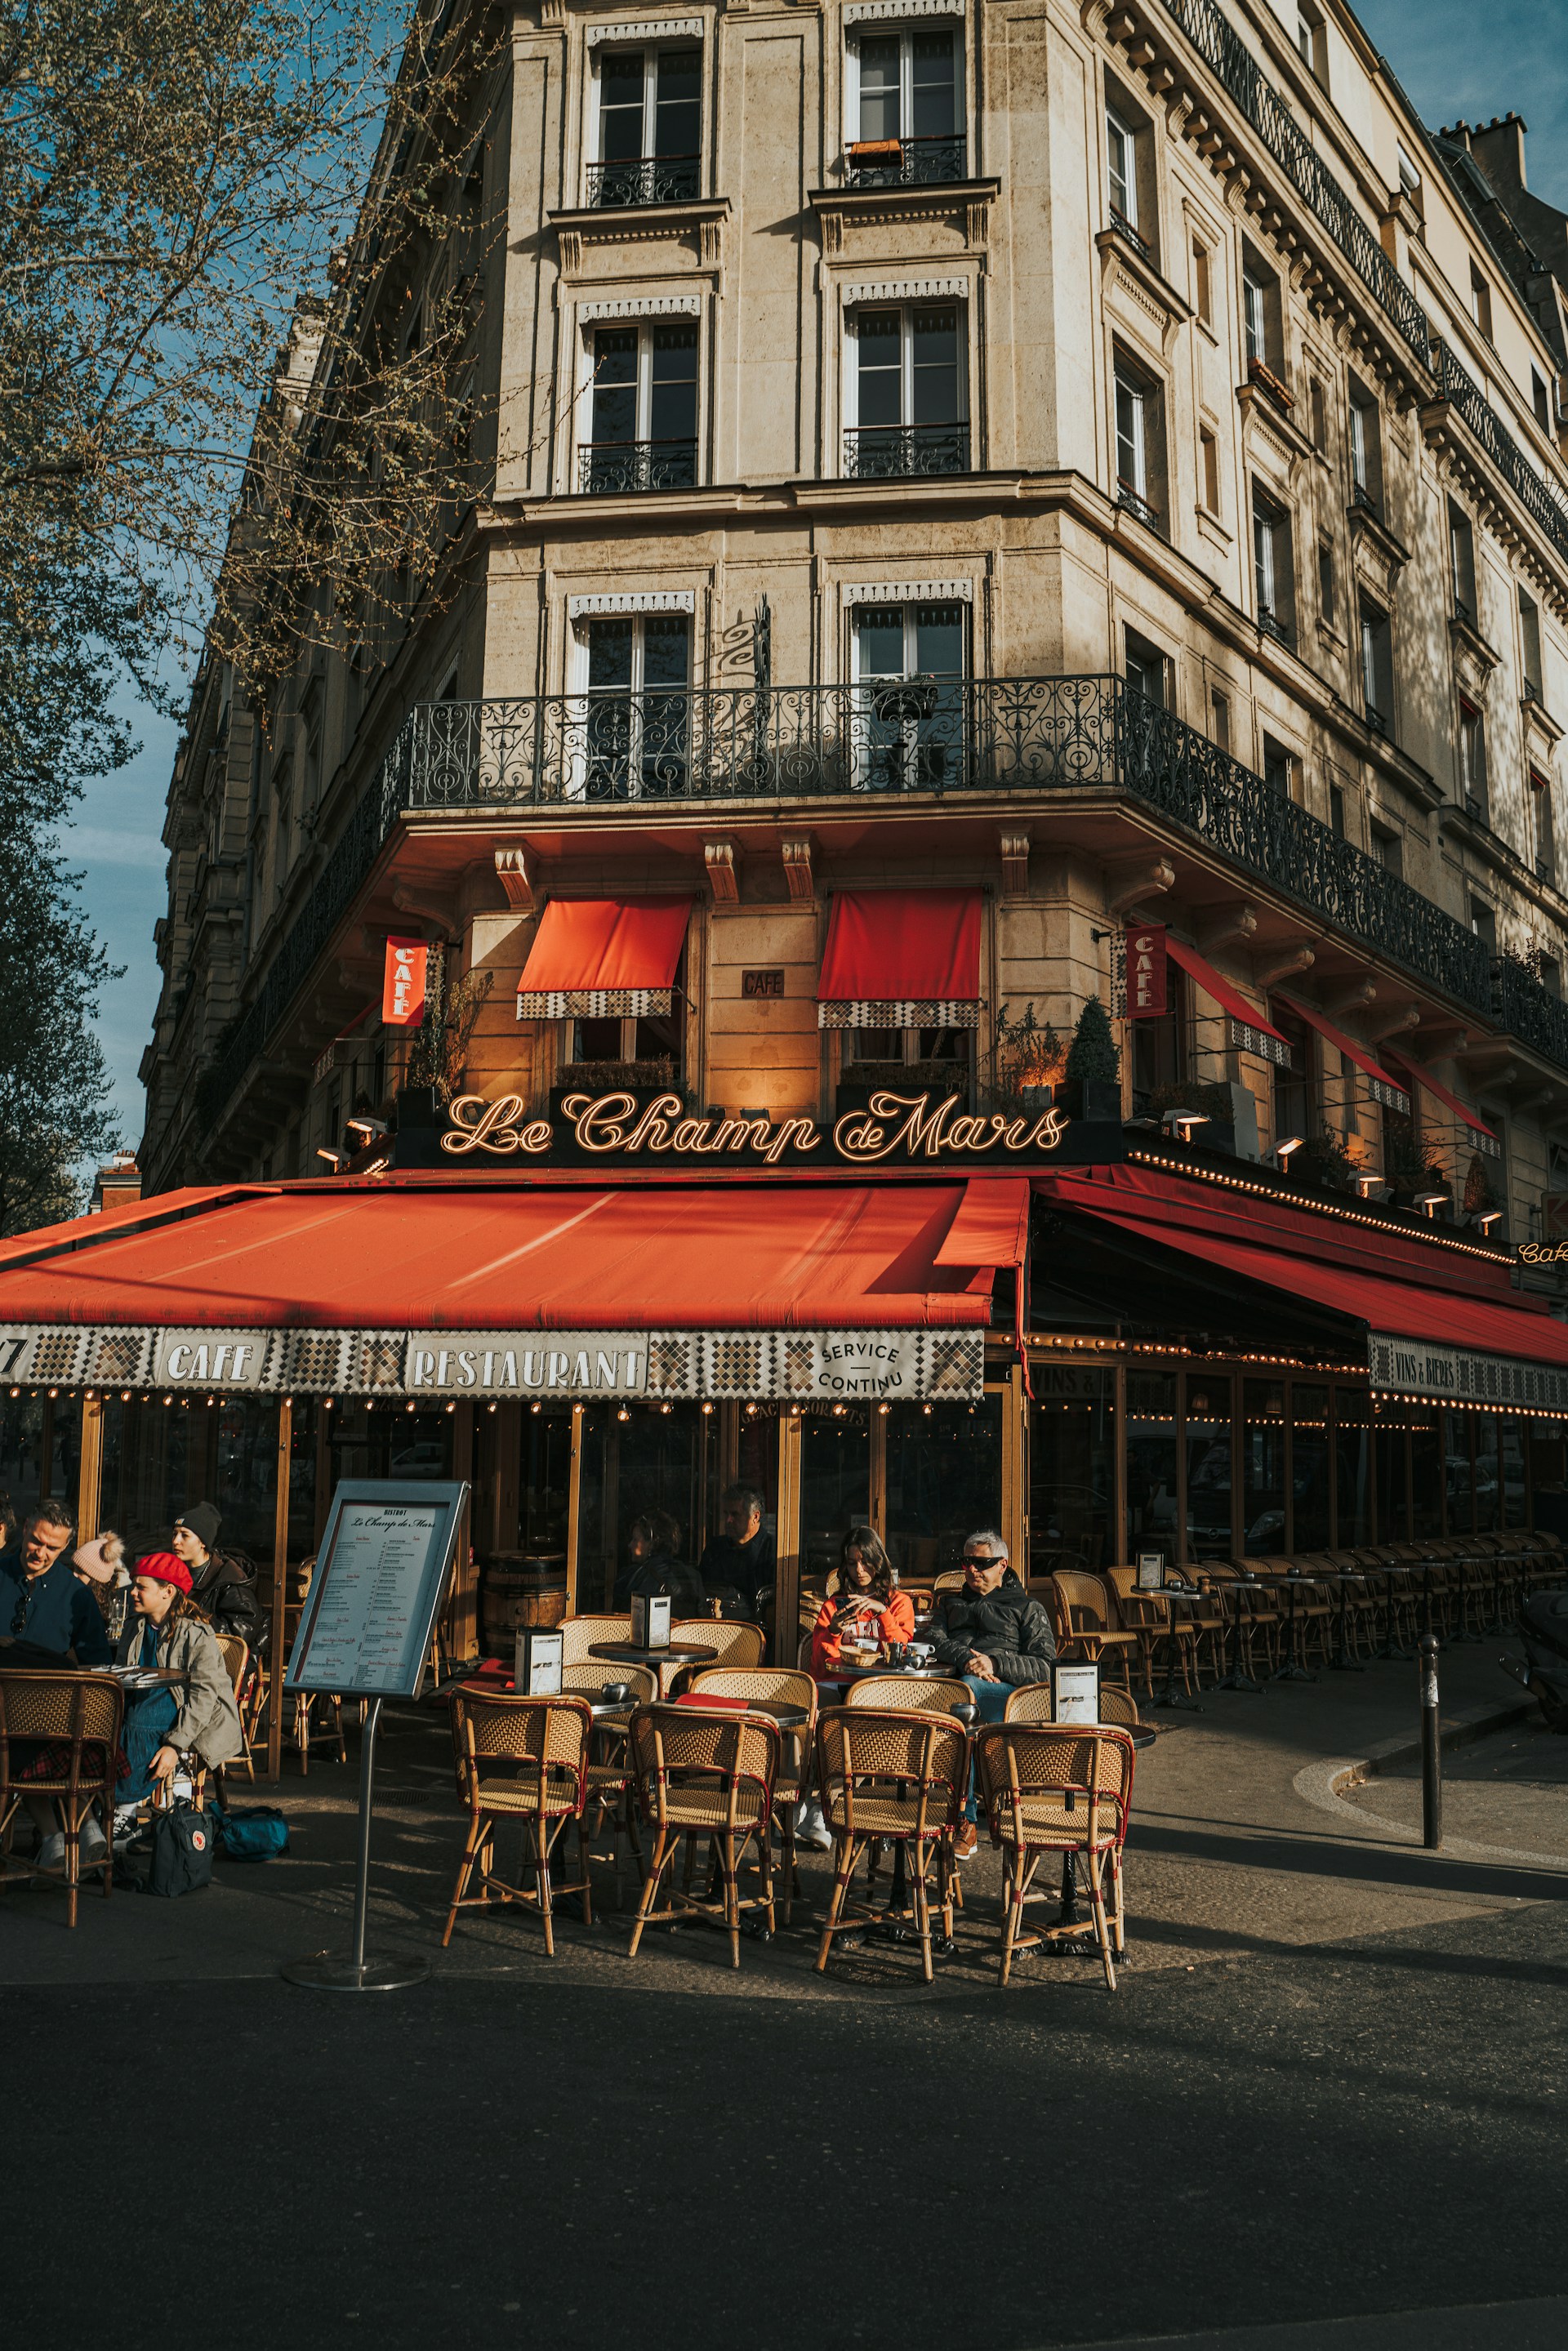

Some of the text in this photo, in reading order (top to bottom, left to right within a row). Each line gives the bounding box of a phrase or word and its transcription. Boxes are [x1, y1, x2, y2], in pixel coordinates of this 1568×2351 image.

[392, 947, 415, 1017] CAFÉ
[744, 972, 782, 995] CAFE
[439, 1090, 1071, 1164] Le Champ de Mars
[0, 1338, 29, 1375] 7
[166, 1343, 254, 1383] CAFE
[412, 1350, 645, 1390] RESTAURANT
[822, 1342, 900, 1363] SERVICE
[1396, 1352, 1417, 1384] VINS
[1418, 1362, 1425, 1385] &
[819, 1371, 902, 1392] CONTINU
[351, 1517, 364, 1527] Le
[364, 1516, 397, 1533] Champ
[398, 1518, 408, 1527] de
